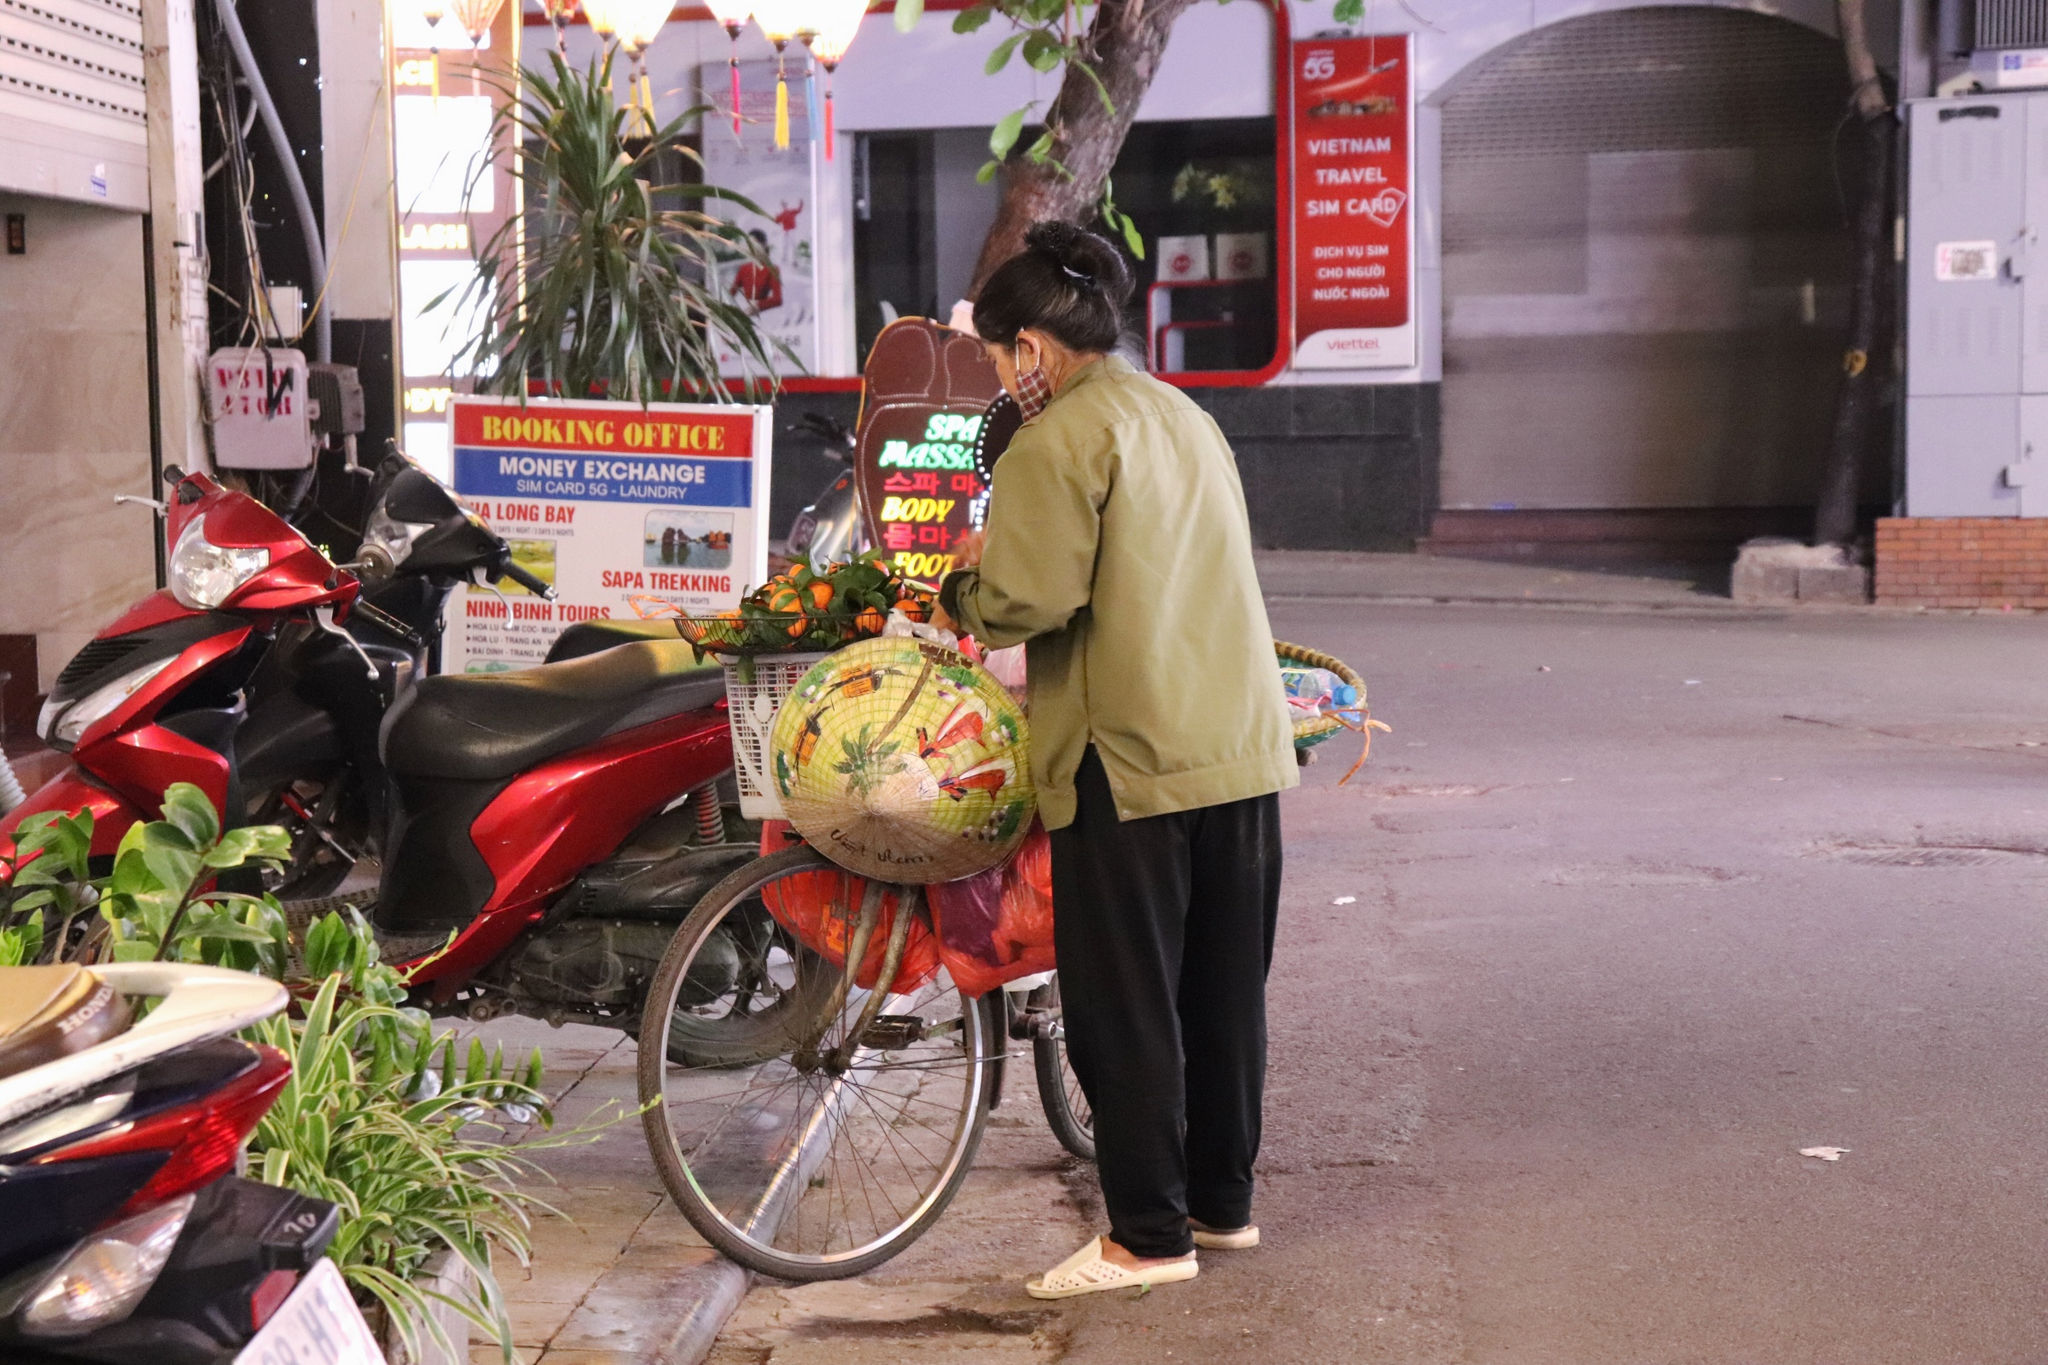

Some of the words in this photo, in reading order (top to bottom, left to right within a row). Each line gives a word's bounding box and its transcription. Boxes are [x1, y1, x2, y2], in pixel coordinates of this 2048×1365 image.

[1307, 136, 1392, 156] VIETNAM
[1315, 167, 1388, 186] TRAVEL
[1306, 198, 1340, 217] SIM
[1346, 197, 1397, 216] CARD
[1366, 244, 1389, 256] SIM
[1317, 266, 1344, 279] CHO
[1350, 284, 1390, 299] NGOÀI
[1326, 338, 1379, 350] viettel
[482, 415, 615, 446] BOOKING
[624, 421, 726, 451] OFFICE
[924, 413, 983, 442] SPA
[499, 456, 578, 479] MONEY
[584, 460, 706, 484] EXCHANGE
[516, 479, 542, 494] SIM
[545, 481, 586, 496] CARD
[589, 483, 609, 497] 5G
[619, 483, 688, 500] LAUNDRY
[883, 471, 941, 497] 스파
[951, 474, 985, 498] 마
[496, 503, 540, 522] LONG
[545, 505, 576, 524] BAY
[880, 496, 955, 523] BODY
[602, 569, 645, 590] SAPA
[650, 572, 731, 593] TREKKING
[466, 599, 507, 619] NINH
[513, 602, 552, 621] BINH
[558, 604, 611, 622] TOURS
